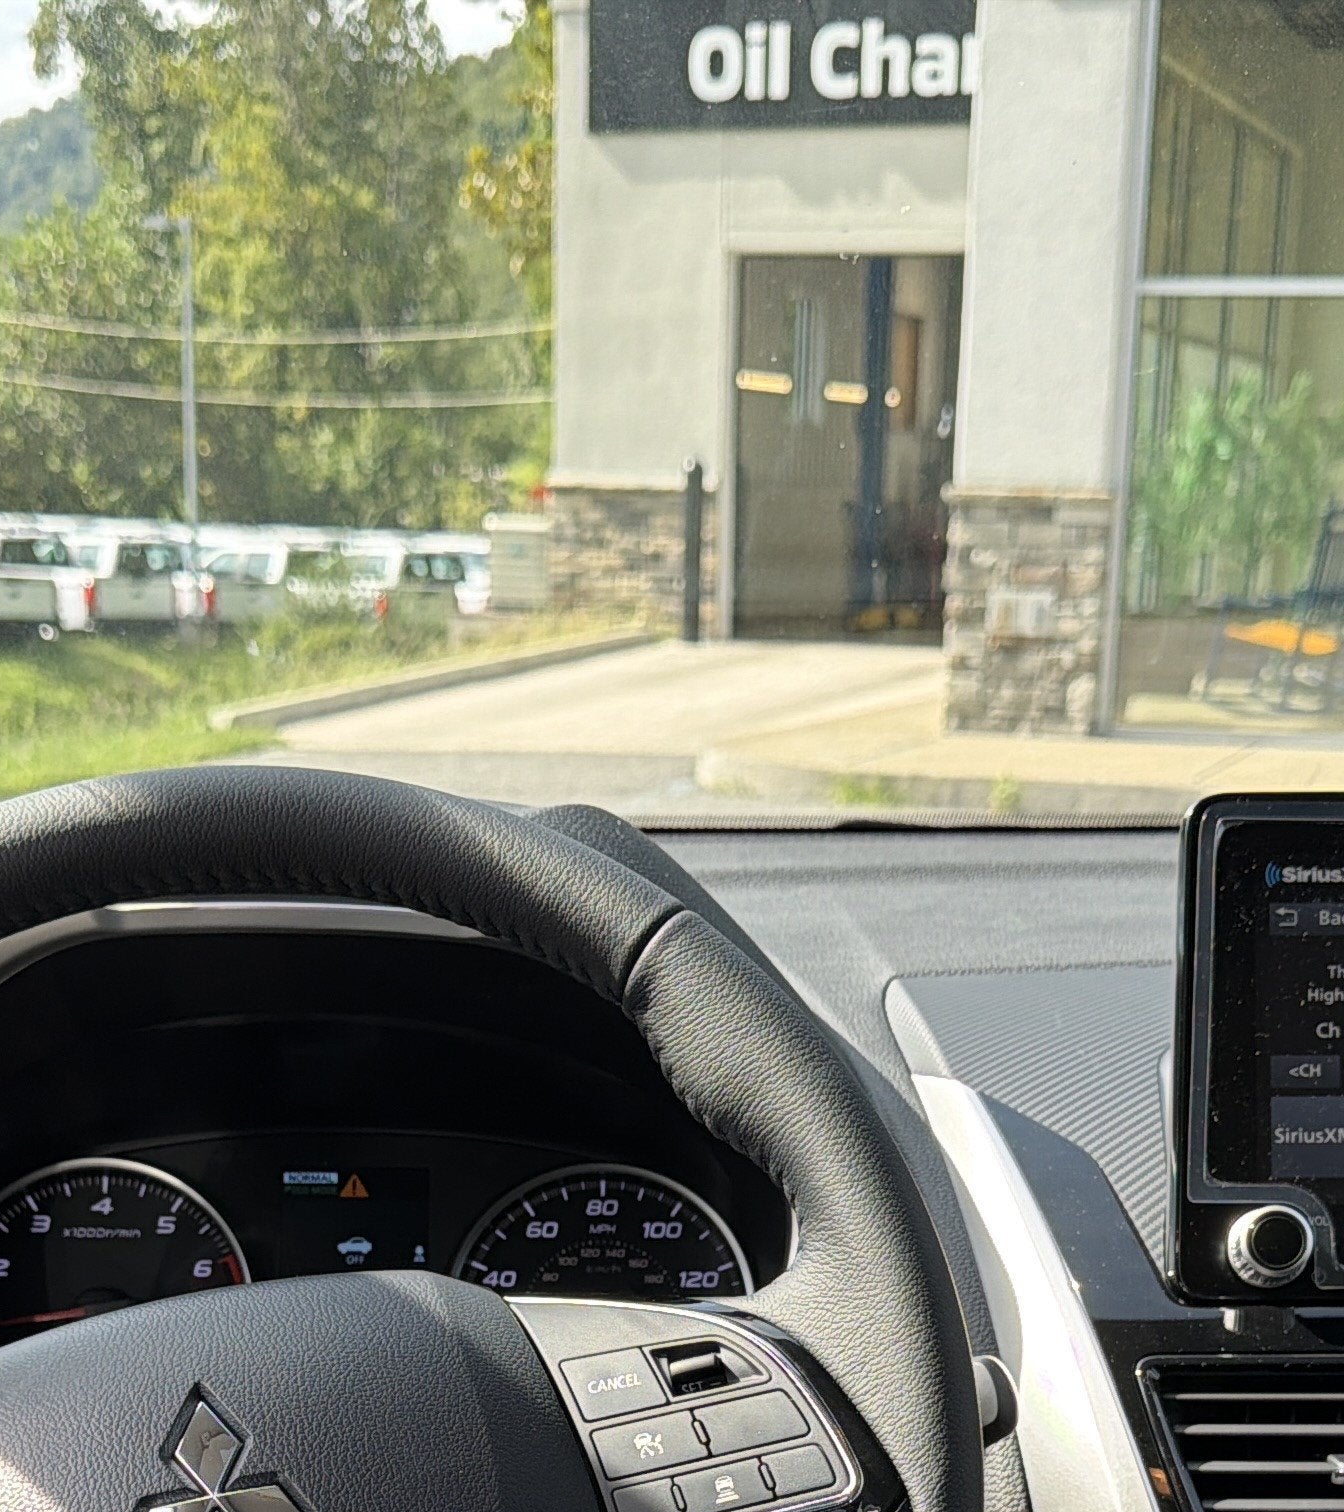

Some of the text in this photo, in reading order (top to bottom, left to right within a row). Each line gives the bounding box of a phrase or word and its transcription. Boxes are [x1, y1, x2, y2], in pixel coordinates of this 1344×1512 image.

[687, 19, 792, 103] Oil
[1316, 1022, 1340, 1039] Ch
[91, 1197, 114, 1215] 4
[585, 1199, 619, 1217] 80
[30, 1215, 52, 1233] 3
[156, 1216, 177, 1235] 5
[525, 1222, 559, 1239] 60
[589, 1224, 617, 1235] MPH
[643, 1222, 683, 1239] 100
[193, 1259, 212, 1278] 6
[483, 1270, 517, 1288] 40
[678, 1271, 719, 1288] 120
[587, 1373, 641, 1395] CANCEL
